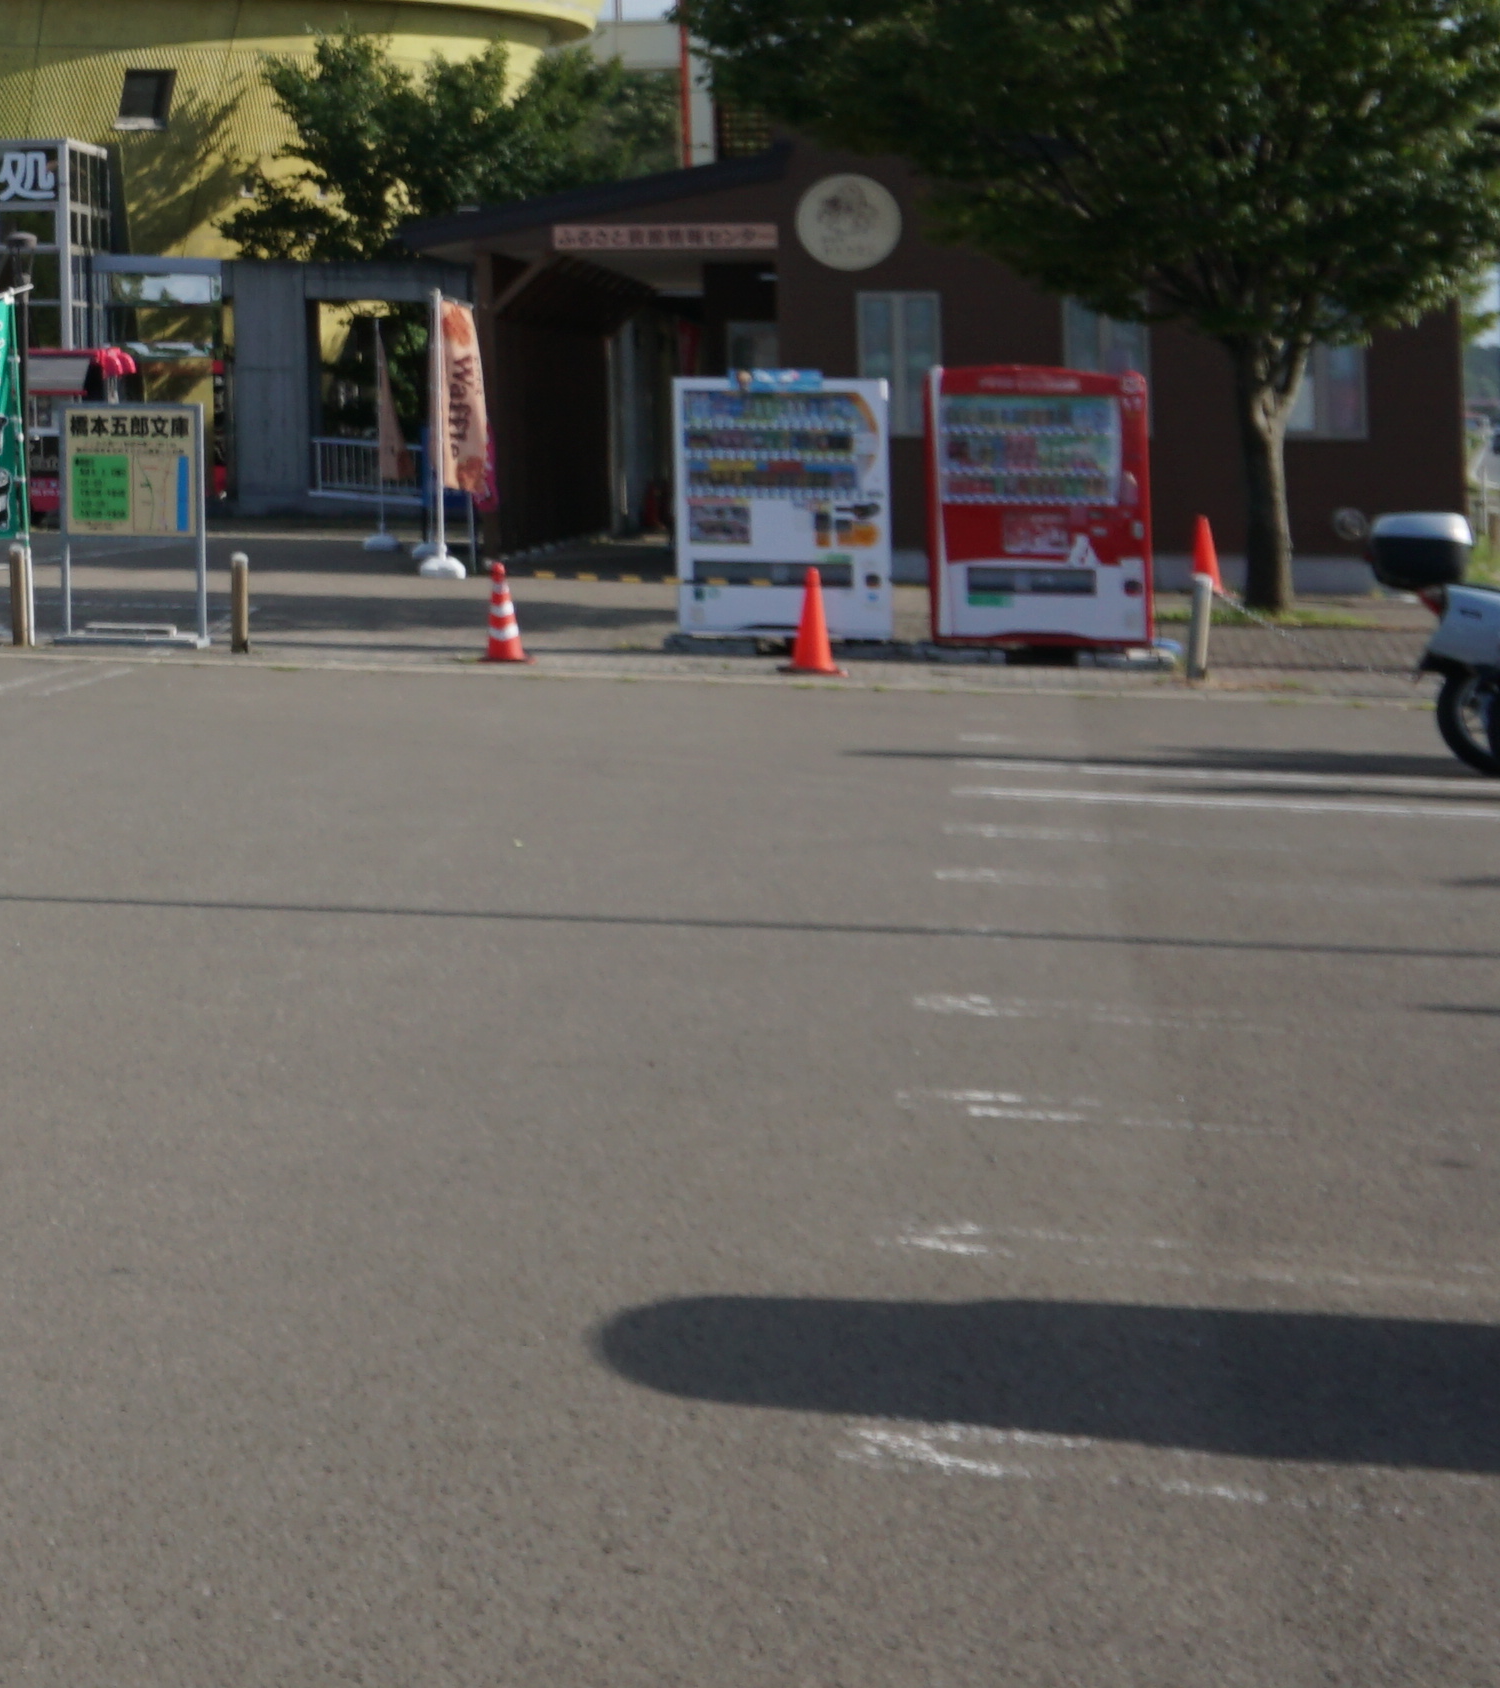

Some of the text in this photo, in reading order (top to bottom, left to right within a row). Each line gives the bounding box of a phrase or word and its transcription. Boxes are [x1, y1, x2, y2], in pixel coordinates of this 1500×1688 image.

[70, 414, 189, 438] 橋本五郎文庫
